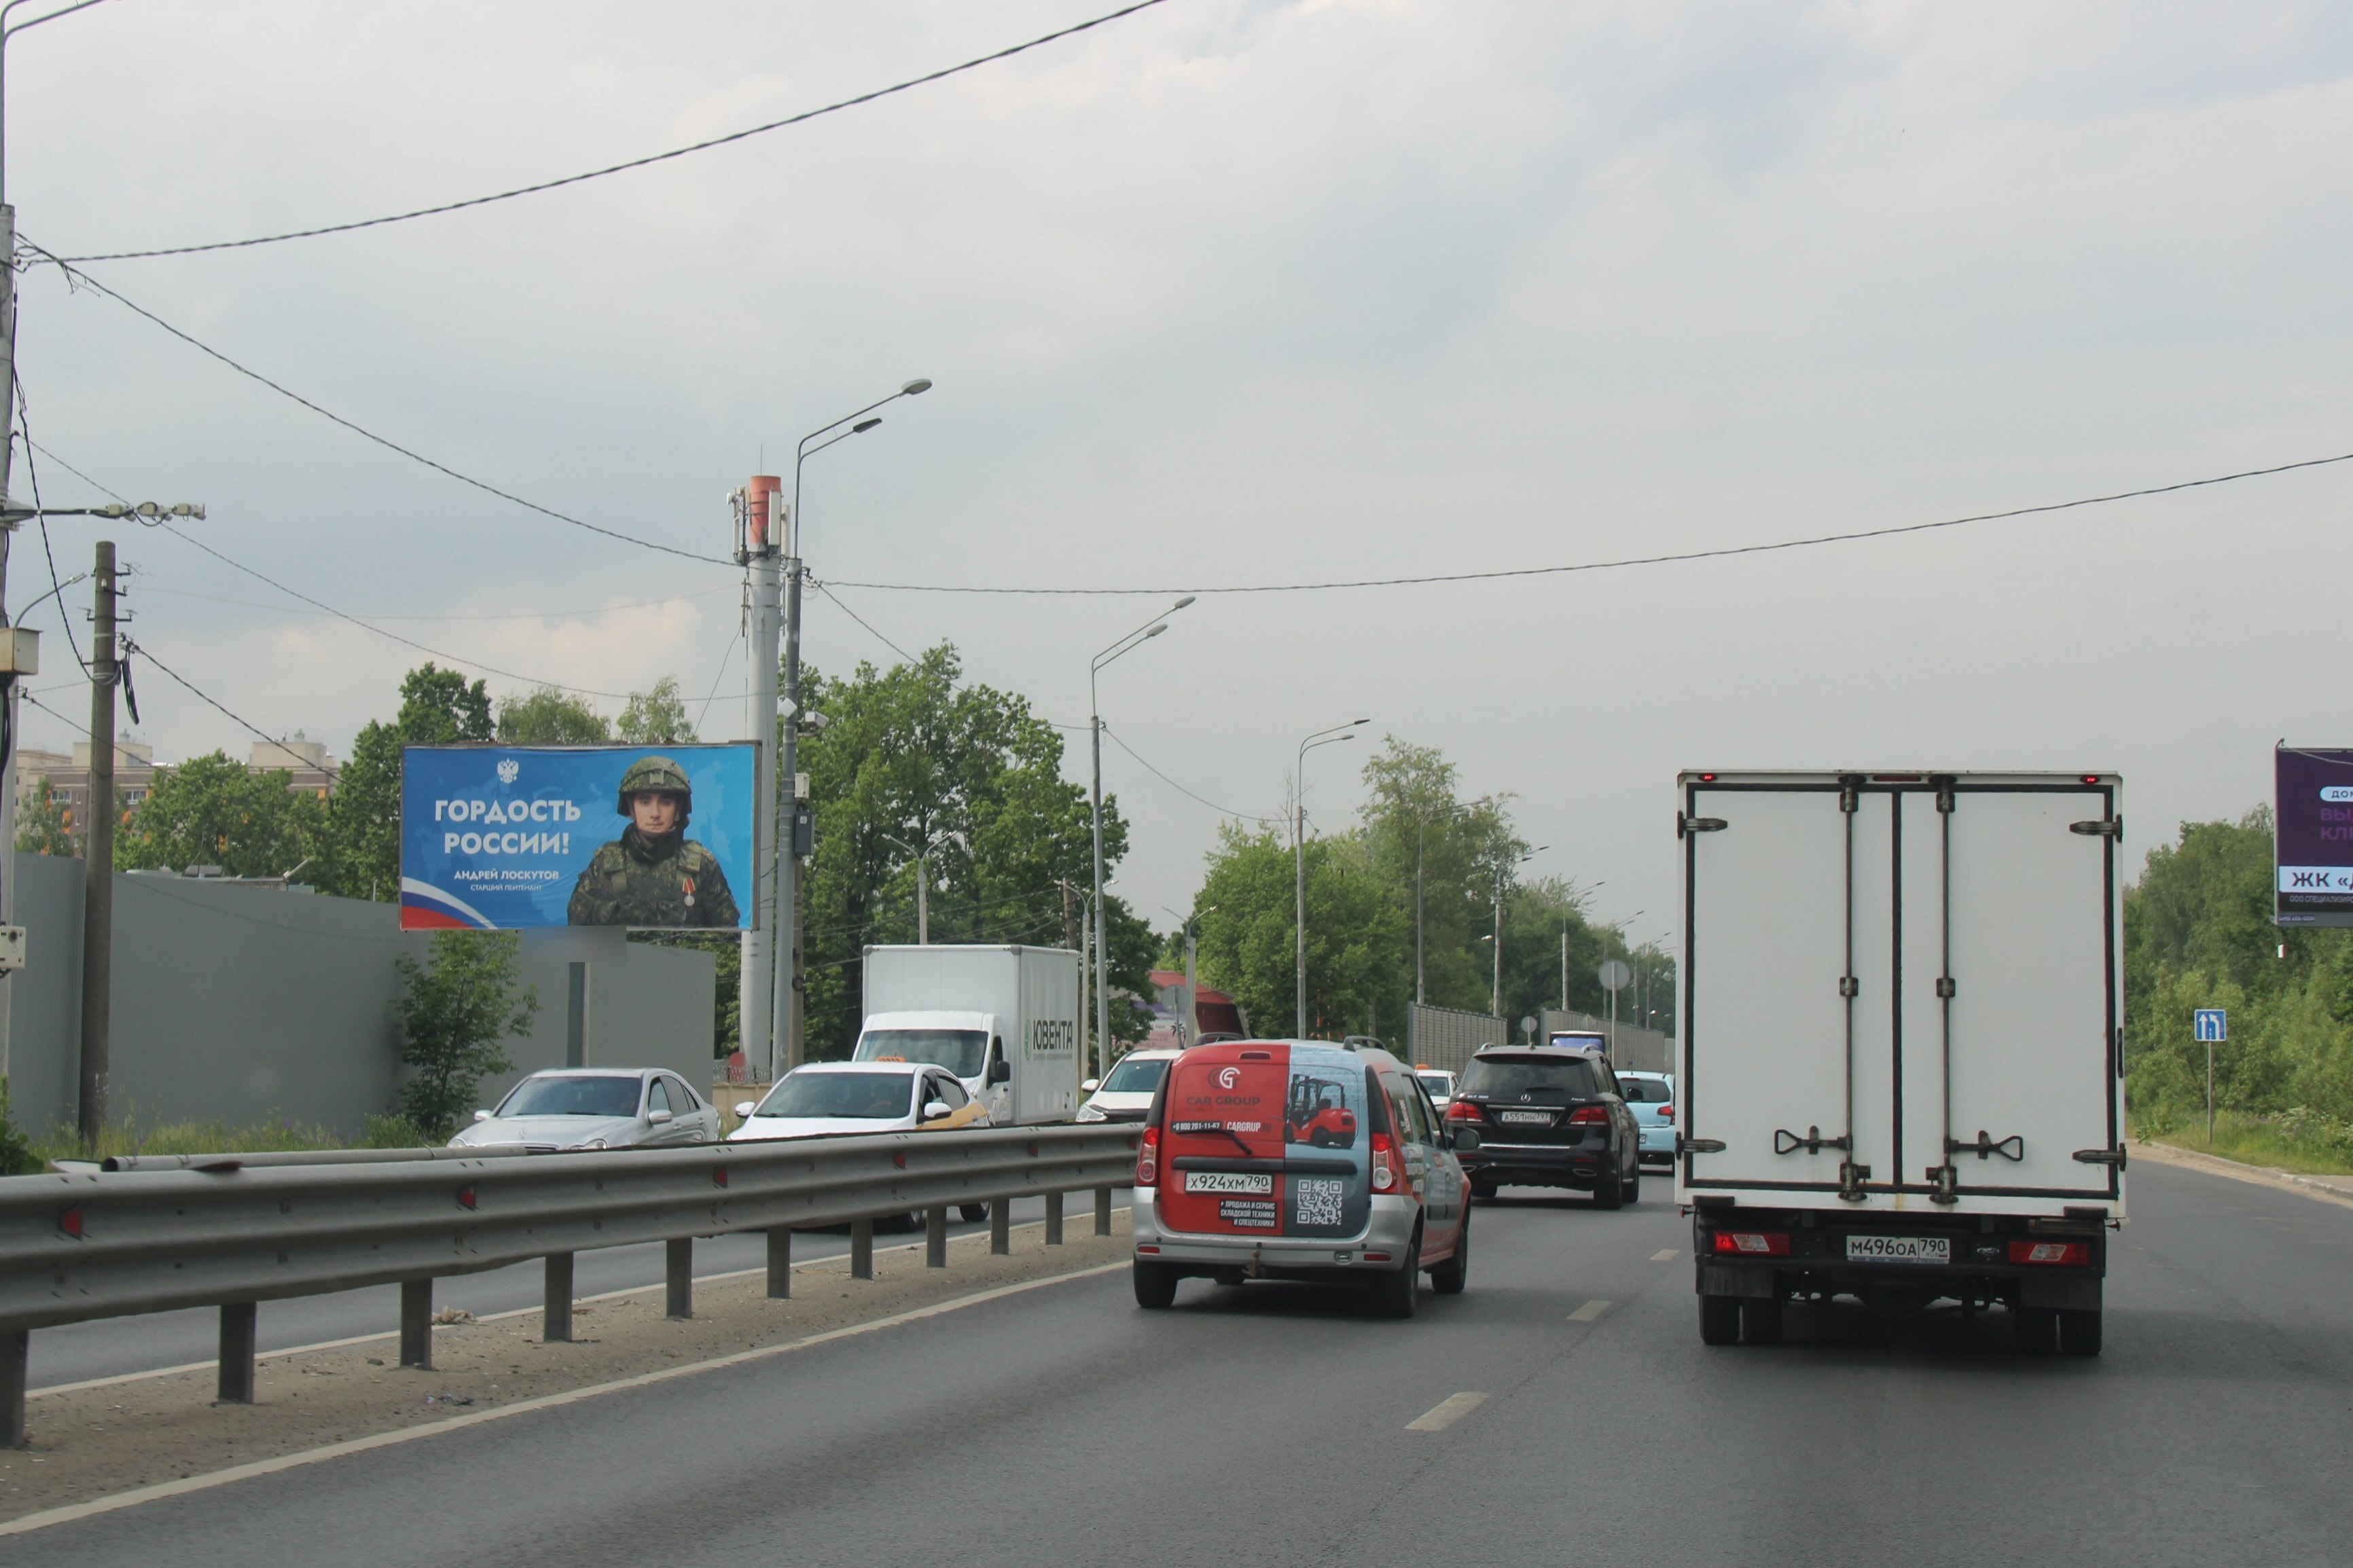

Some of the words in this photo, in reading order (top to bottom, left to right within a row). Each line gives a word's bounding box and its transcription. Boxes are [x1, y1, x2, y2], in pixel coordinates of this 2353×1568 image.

[435, 799, 581, 824] ГОРДОСТЬ
[2320, 826, 2353, 840] КЛ
[445, 832, 569, 854] РОССИИ!
[454, 869, 498, 881] АНДРЕЙ
[501, 870, 560, 880] ЛОСКУТОВ
[2292, 872, 2331, 887] ЖК
[471, 883, 503, 892] СТАРШИЙ
[2289, 894, 2304, 902] ООО
[1033, 1019, 1073, 1050] ЮВЕНТА
[1186, 1097, 1212, 1106] CAR
[1215, 1096, 1261, 1106] GROUP
[1225, 1200, 1251, 1209] ПРОДАЖА
[1256, 1202, 1276, 1210] СЕРВИС
[1221, 1209, 1251, 1218] СКЛАДСКОЙ
[1252, 1210, 1275, 1218] ТЕХНИКИ
[1238, 1218, 1275, 1227] СПЕЦТЕХНИКИ
